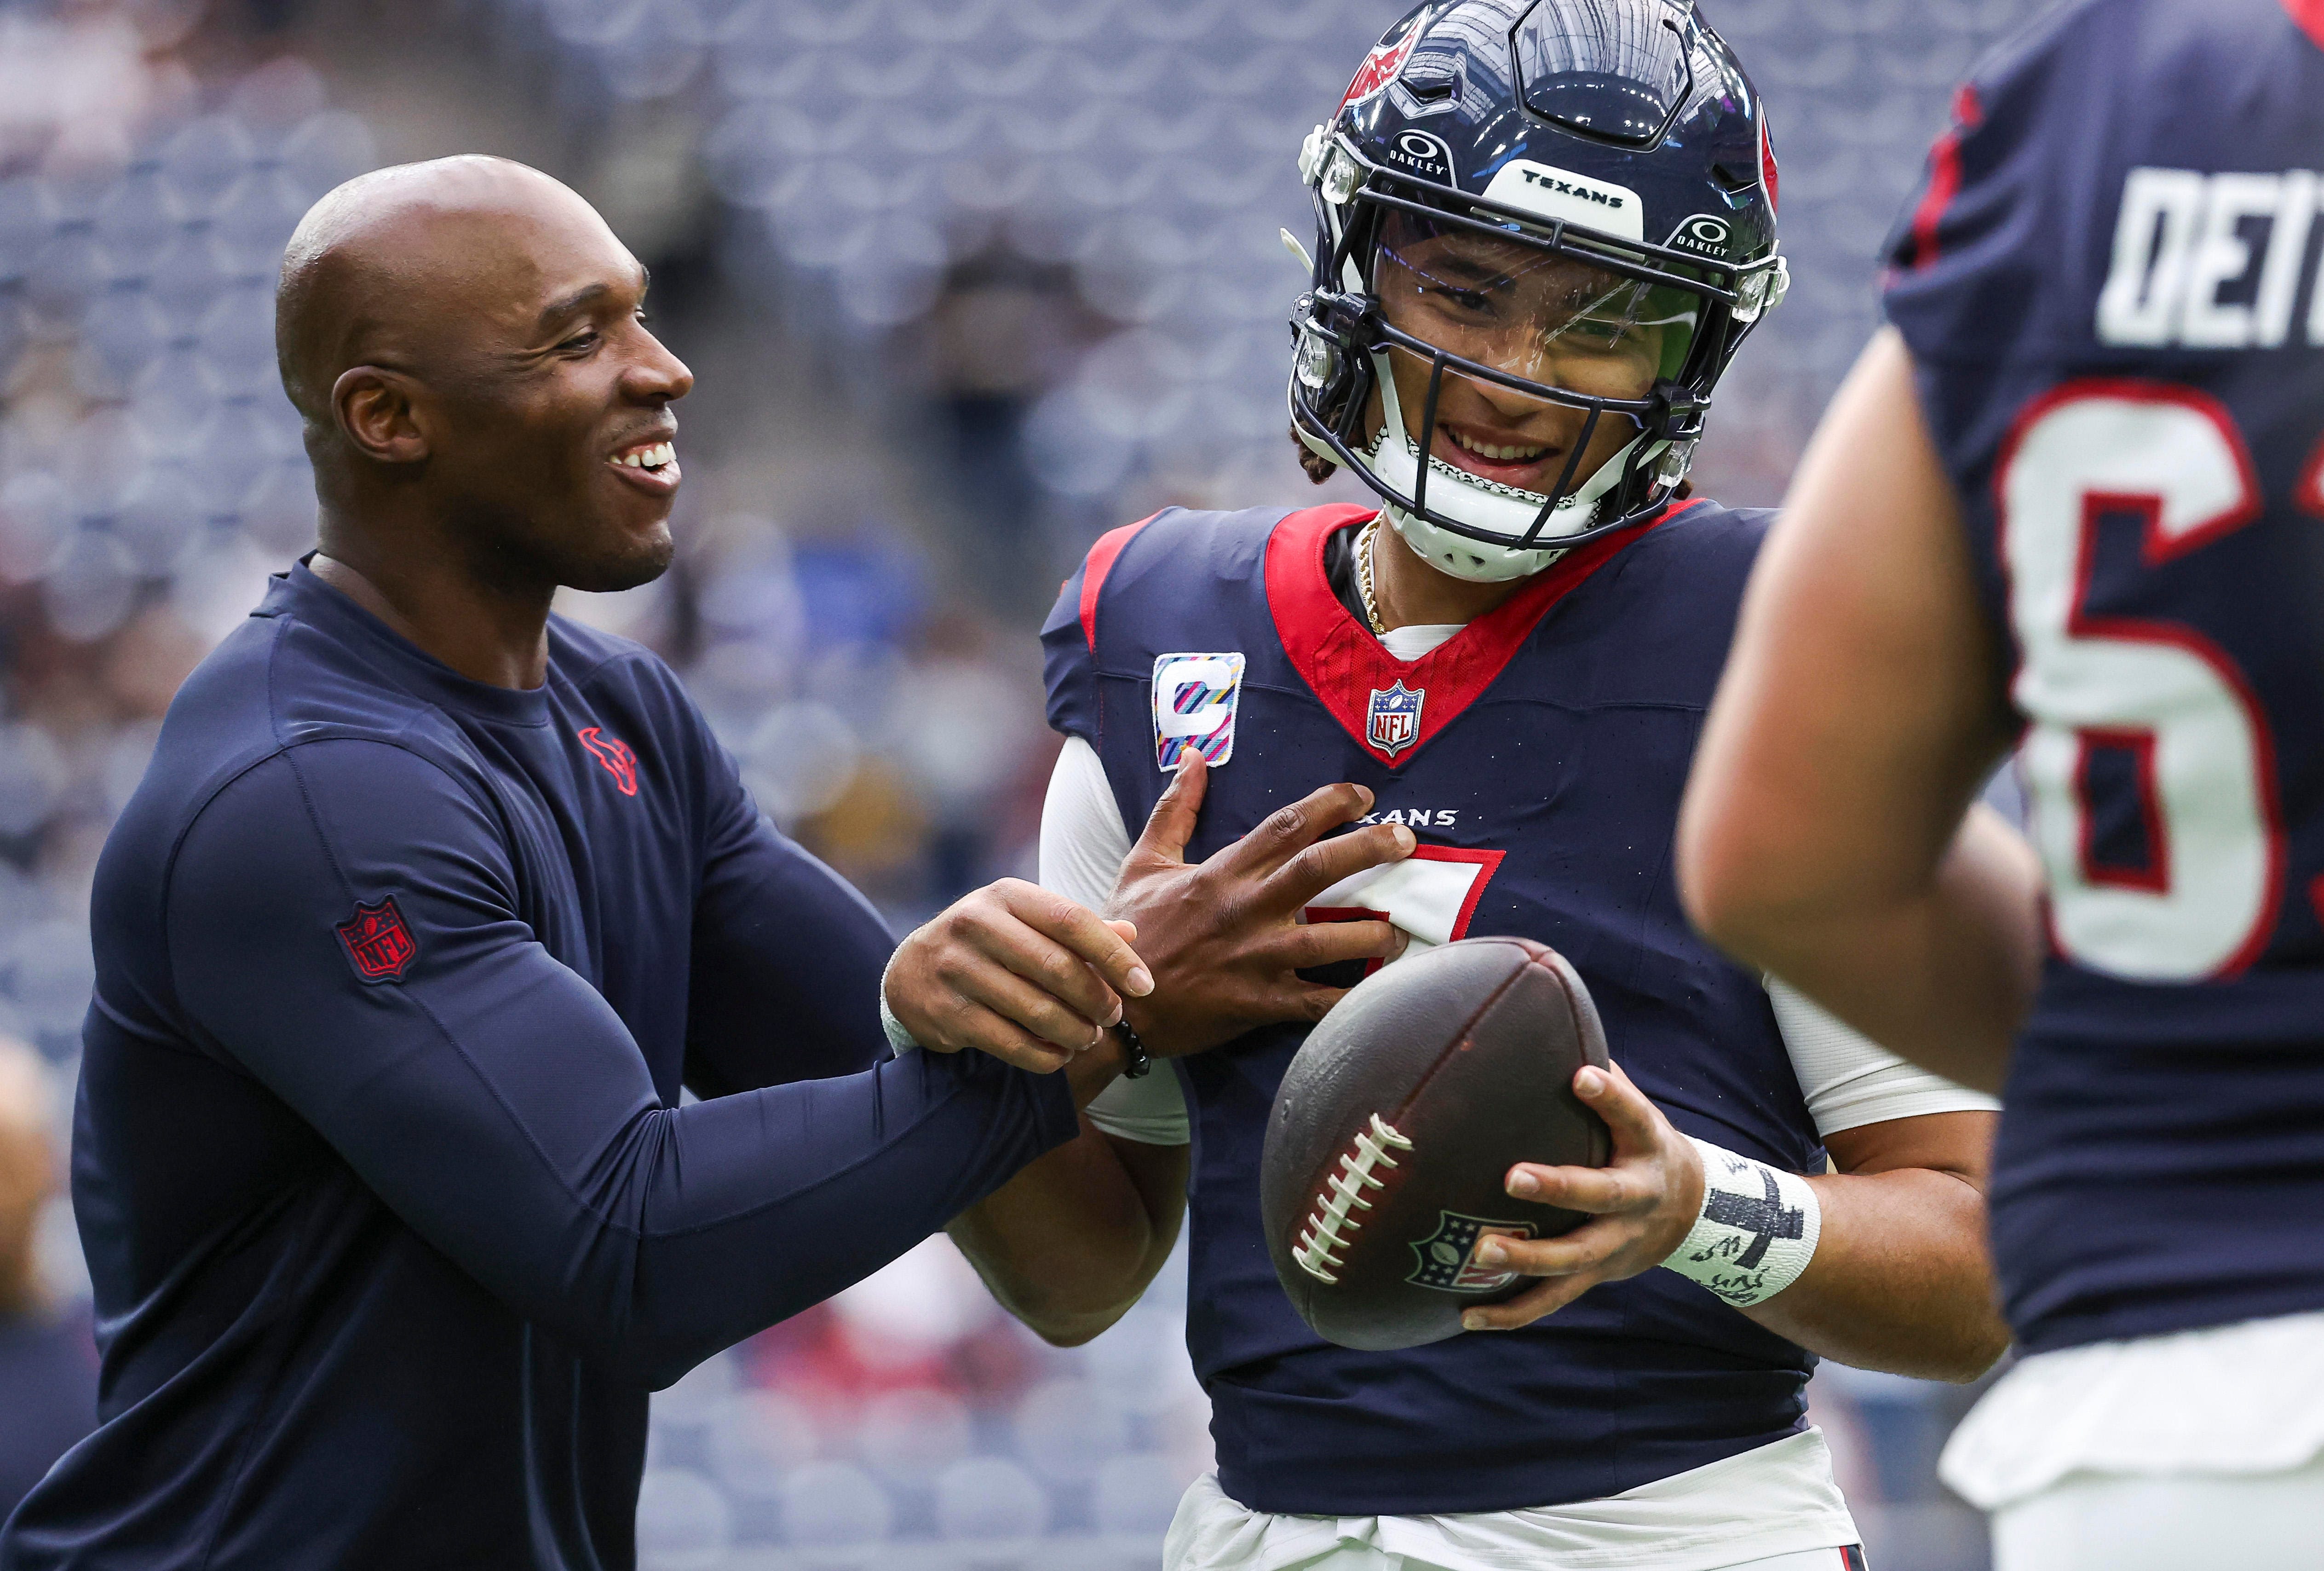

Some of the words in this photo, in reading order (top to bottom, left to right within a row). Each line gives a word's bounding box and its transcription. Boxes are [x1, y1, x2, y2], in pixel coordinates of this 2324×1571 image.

[1390, 149, 1444, 175] OAKLEY
[1522, 169, 1623, 208] TEXANS
[1677, 235, 1728, 256] OAKLEY
[2094, 165, 2324, 350] DEI
[1157, 659, 1231, 738] C
[1374, 715, 1409, 743] NFL
[1355, 808, 1460, 827] XANS
[358, 929, 410, 969] NFL
